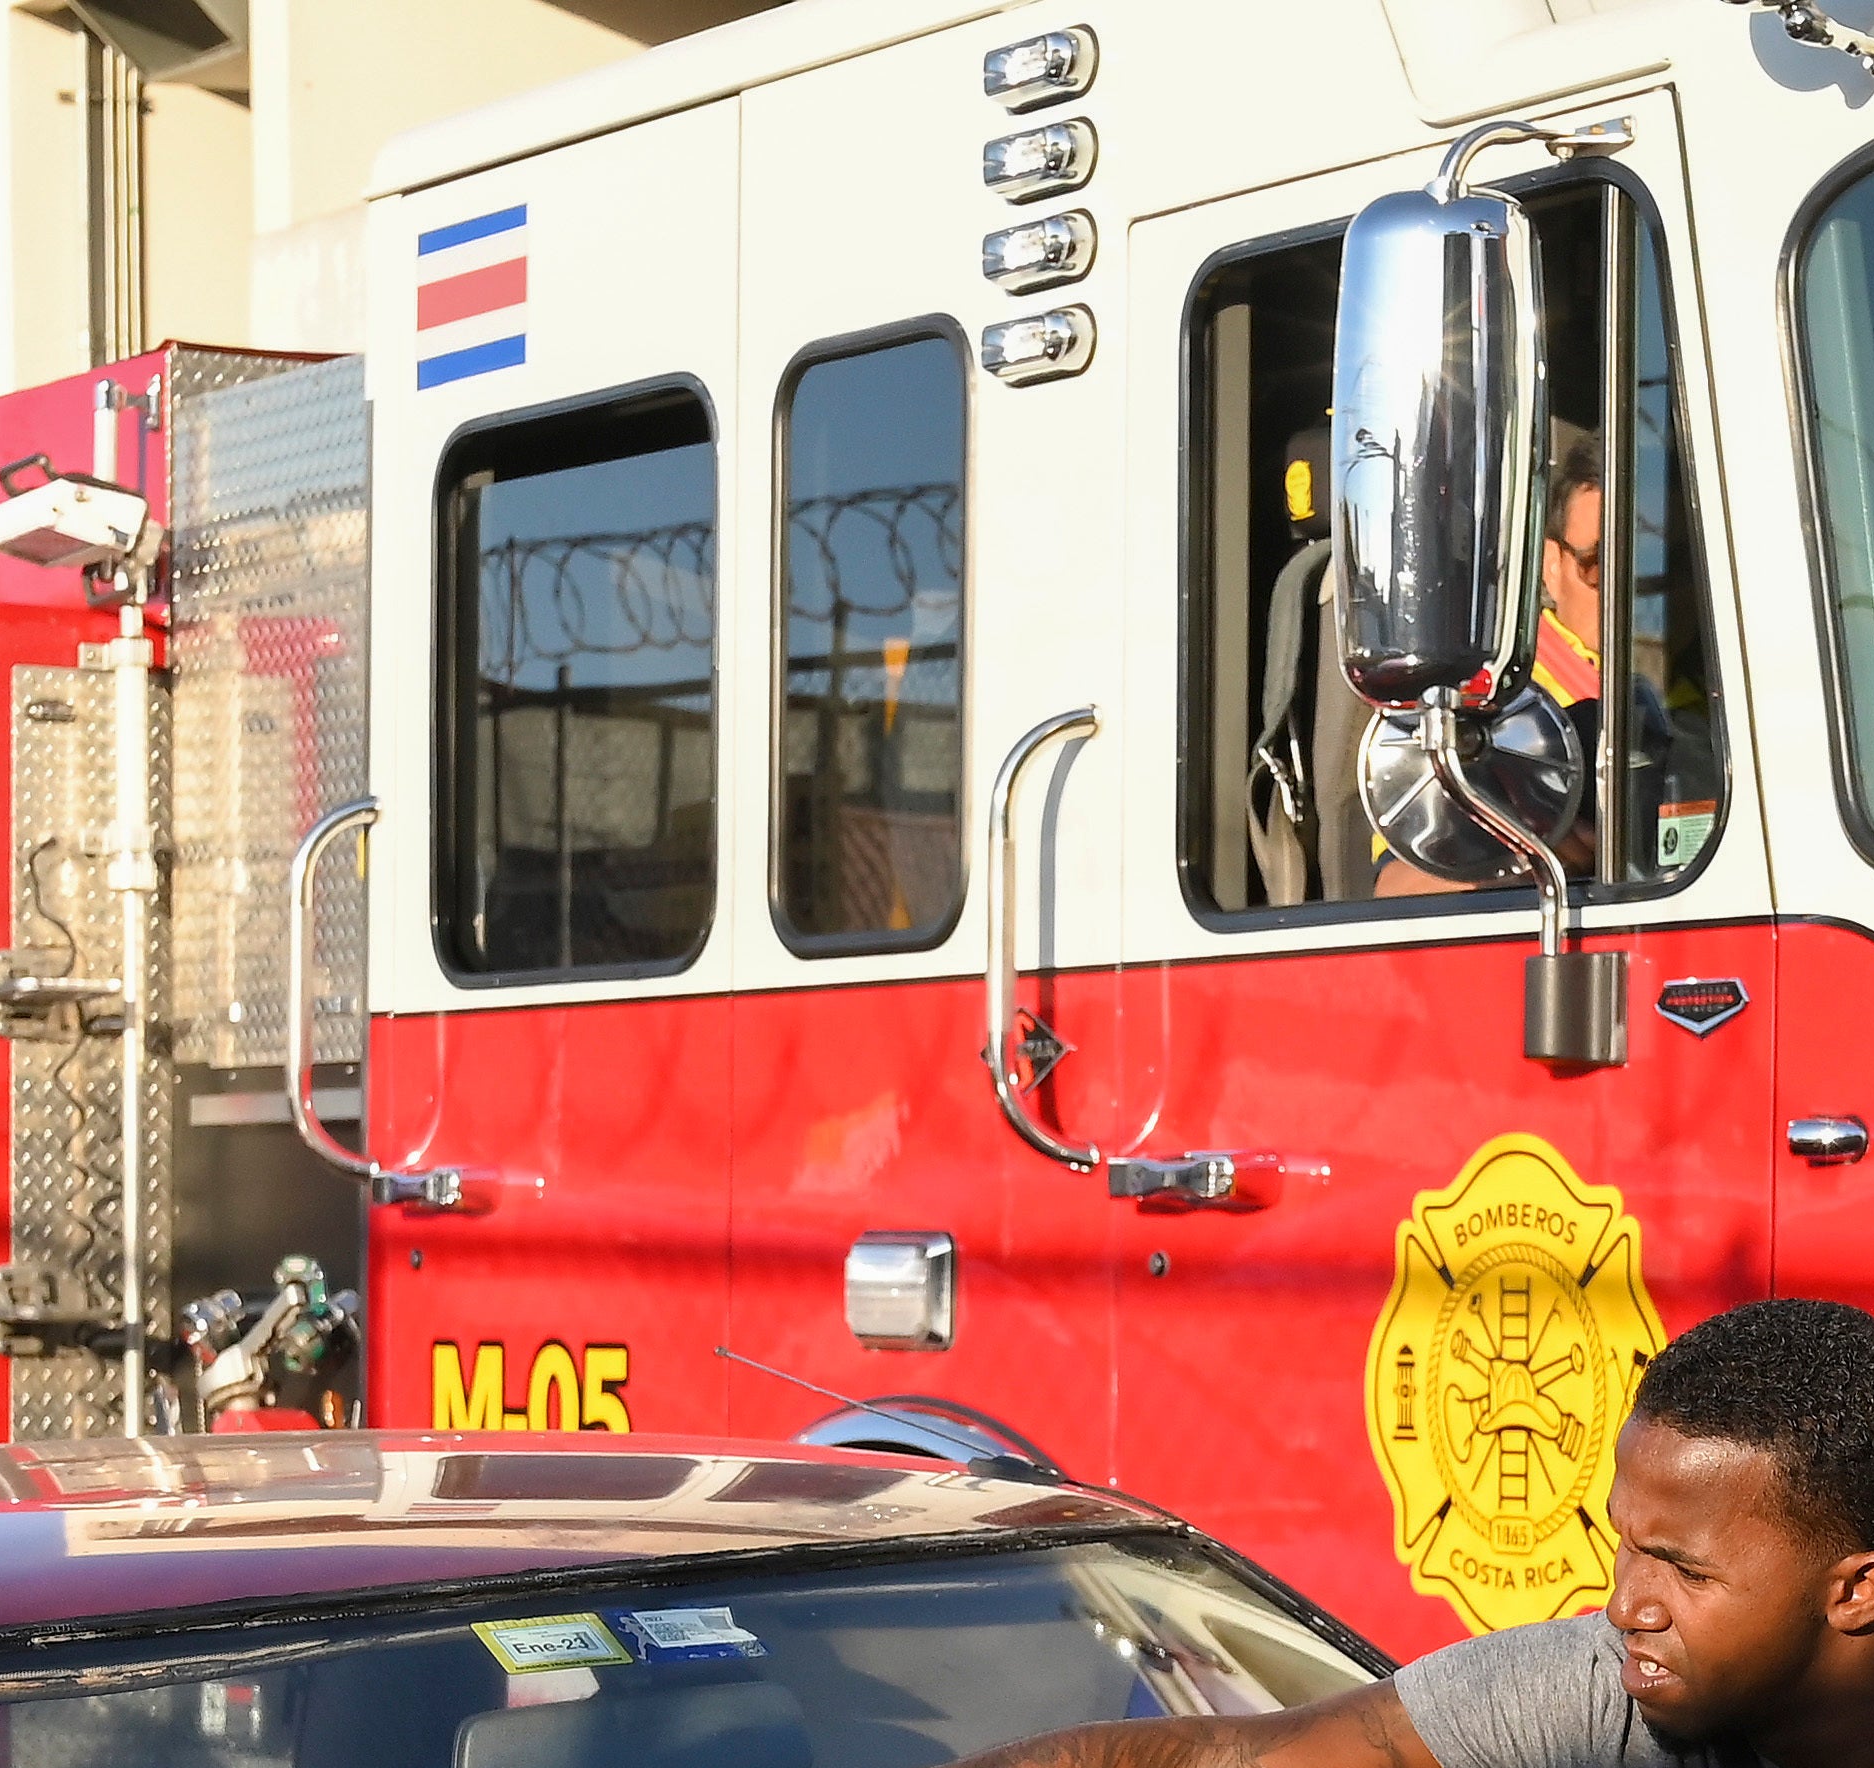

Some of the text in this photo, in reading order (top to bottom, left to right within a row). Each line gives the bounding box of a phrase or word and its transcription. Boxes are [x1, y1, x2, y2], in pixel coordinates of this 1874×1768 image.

[1453, 1203, 1578, 1248] BOMBEROS
[1449, 1548, 1574, 1589] COSTA RICA
[513, 1636, 589, 1655] Ene-23
